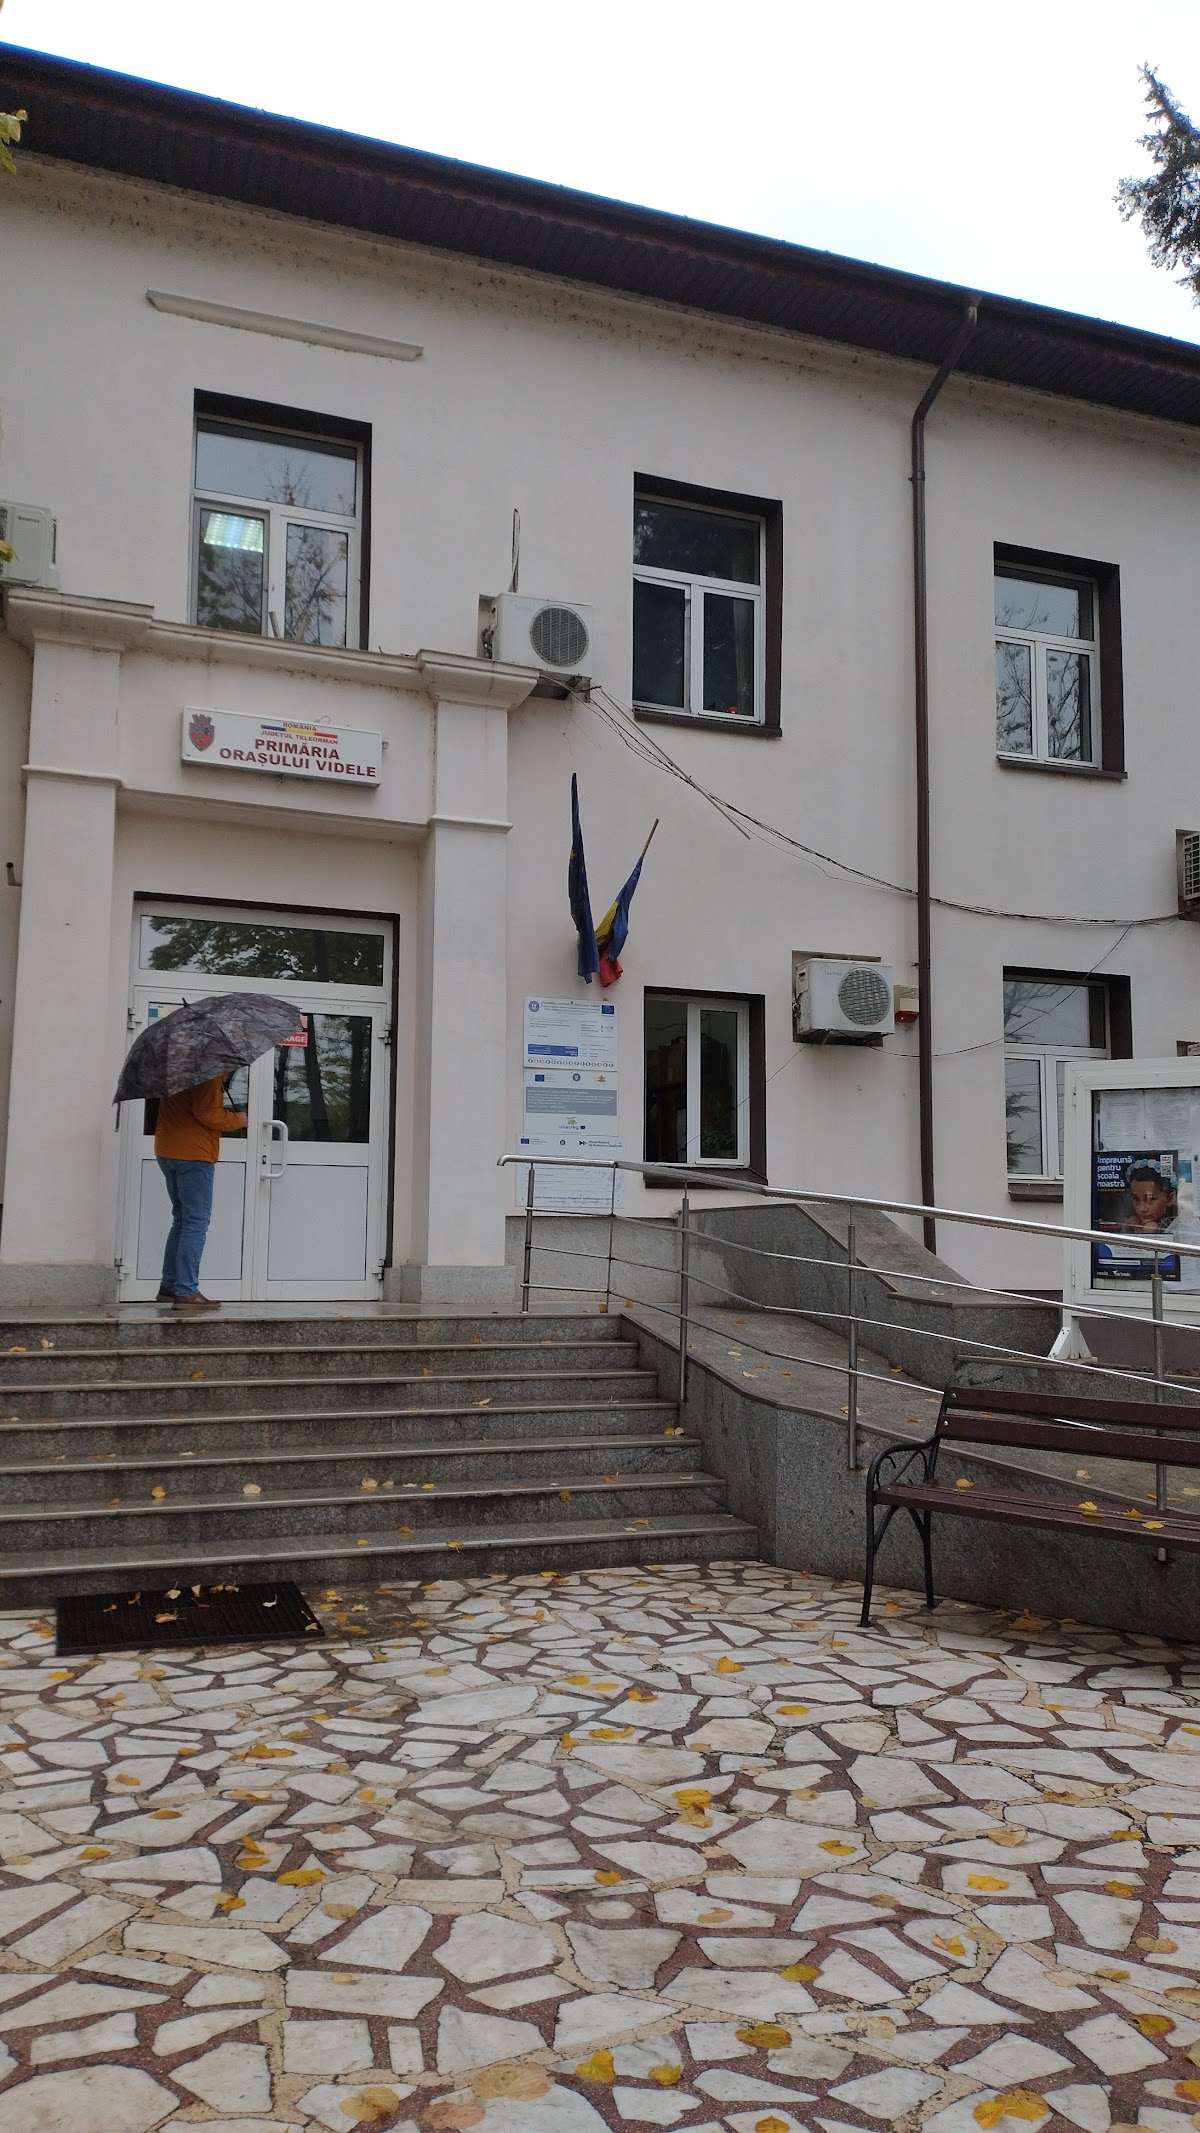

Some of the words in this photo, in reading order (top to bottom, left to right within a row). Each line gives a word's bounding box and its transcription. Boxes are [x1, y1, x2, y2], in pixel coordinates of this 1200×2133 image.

[295, 734, 338, 745] TELEORMAN
[255, 738, 340, 760] PRIMĂRIA
[219, 747, 310, 769] ORAȘULUI
[316, 759, 376, 777] VIDELE
[1097, 1164, 1121, 1173] pentru
[1097, 1172, 1120, 1181] școala
[1097, 1179, 1125, 1188] noastră
